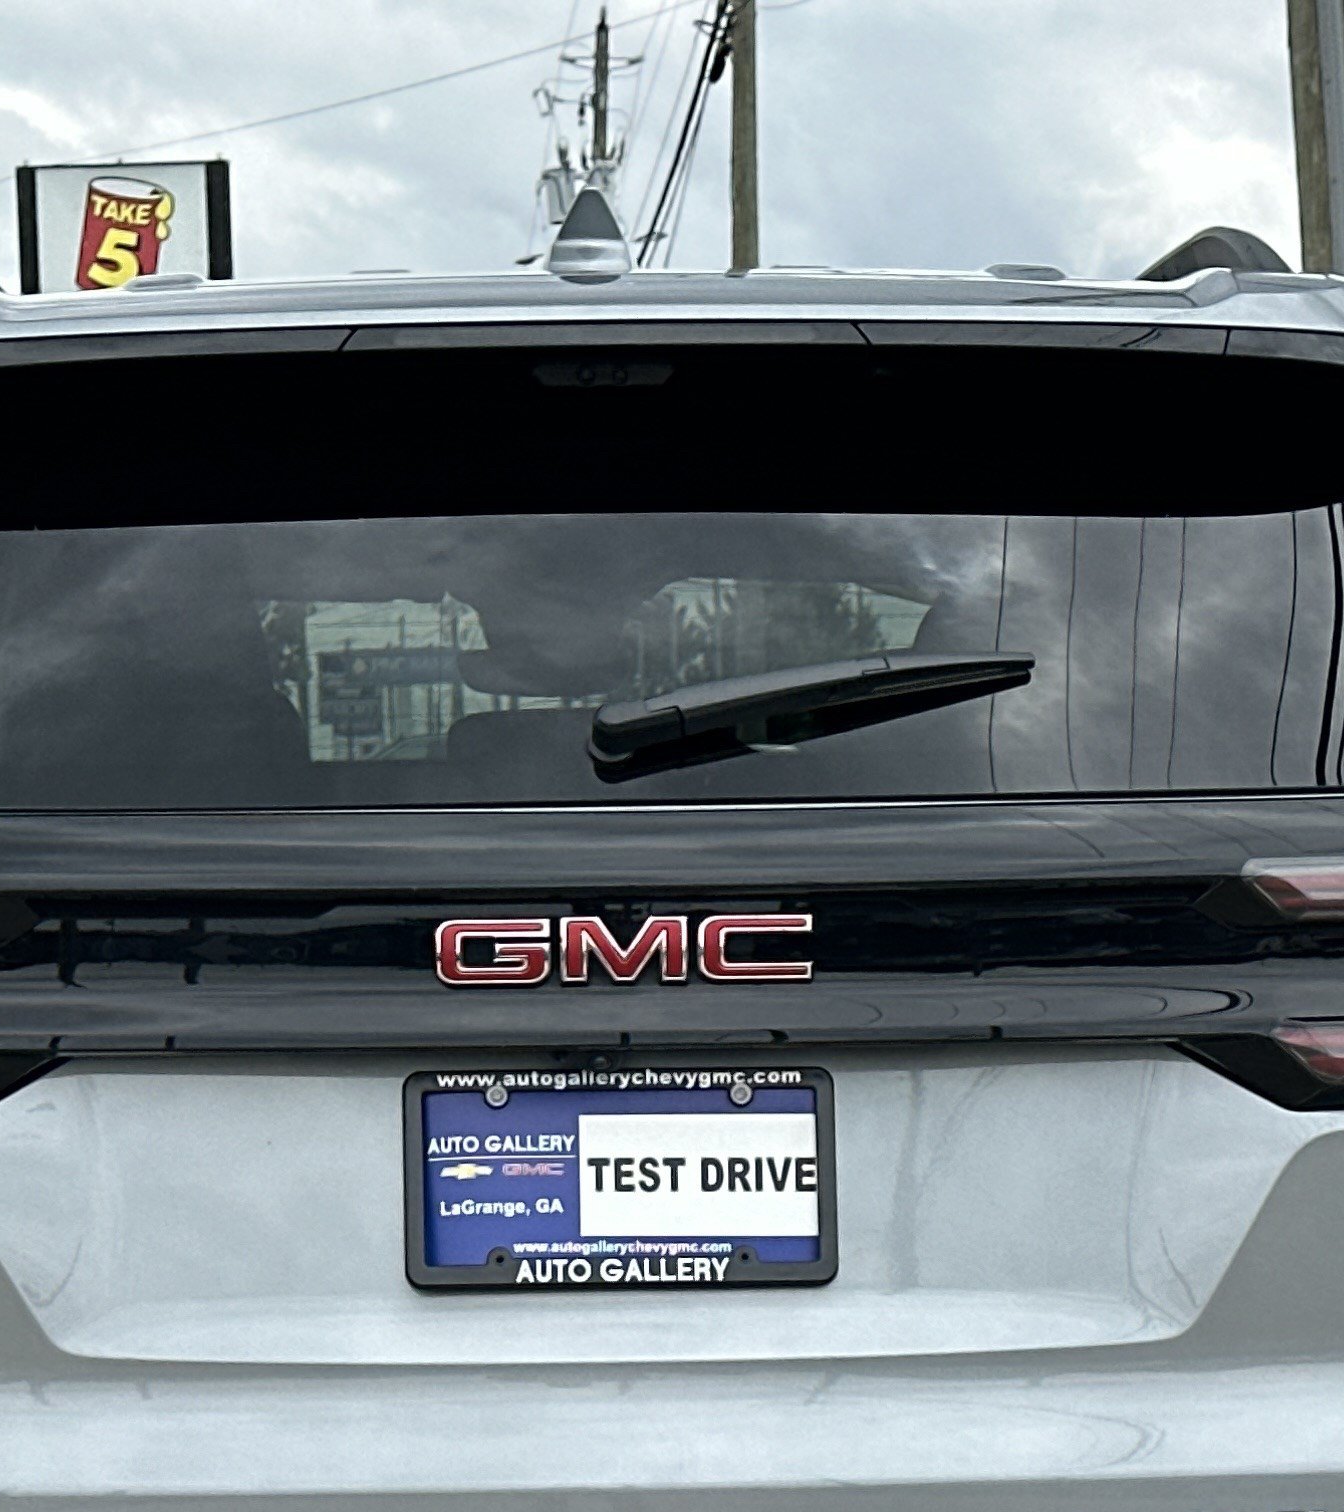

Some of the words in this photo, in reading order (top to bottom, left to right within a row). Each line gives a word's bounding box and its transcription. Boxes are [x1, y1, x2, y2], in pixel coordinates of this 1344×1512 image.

[90, 194, 152, 226] TAKE
[87, 227, 140, 287] 5
[434, 914, 813, 985] GMC
[437, 1069, 801, 1090] www.autogallerychevygmc.com
[427, 1136, 480, 1154] AUTO
[484, 1134, 576, 1153] GALLERY
[502, 1163, 565, 1176] GMC
[587, 1157, 686, 1192] TEST
[701, 1157, 818, 1192] DRIVE
[440, 1199, 531, 1217] LaGrange,
[536, 1198, 564, 1214] GA
[513, 1240, 732, 1256] www.autogallerychevygmc.com
[516, 1258, 592, 1283] AUTO
[599, 1257, 729, 1283] GALLERY
